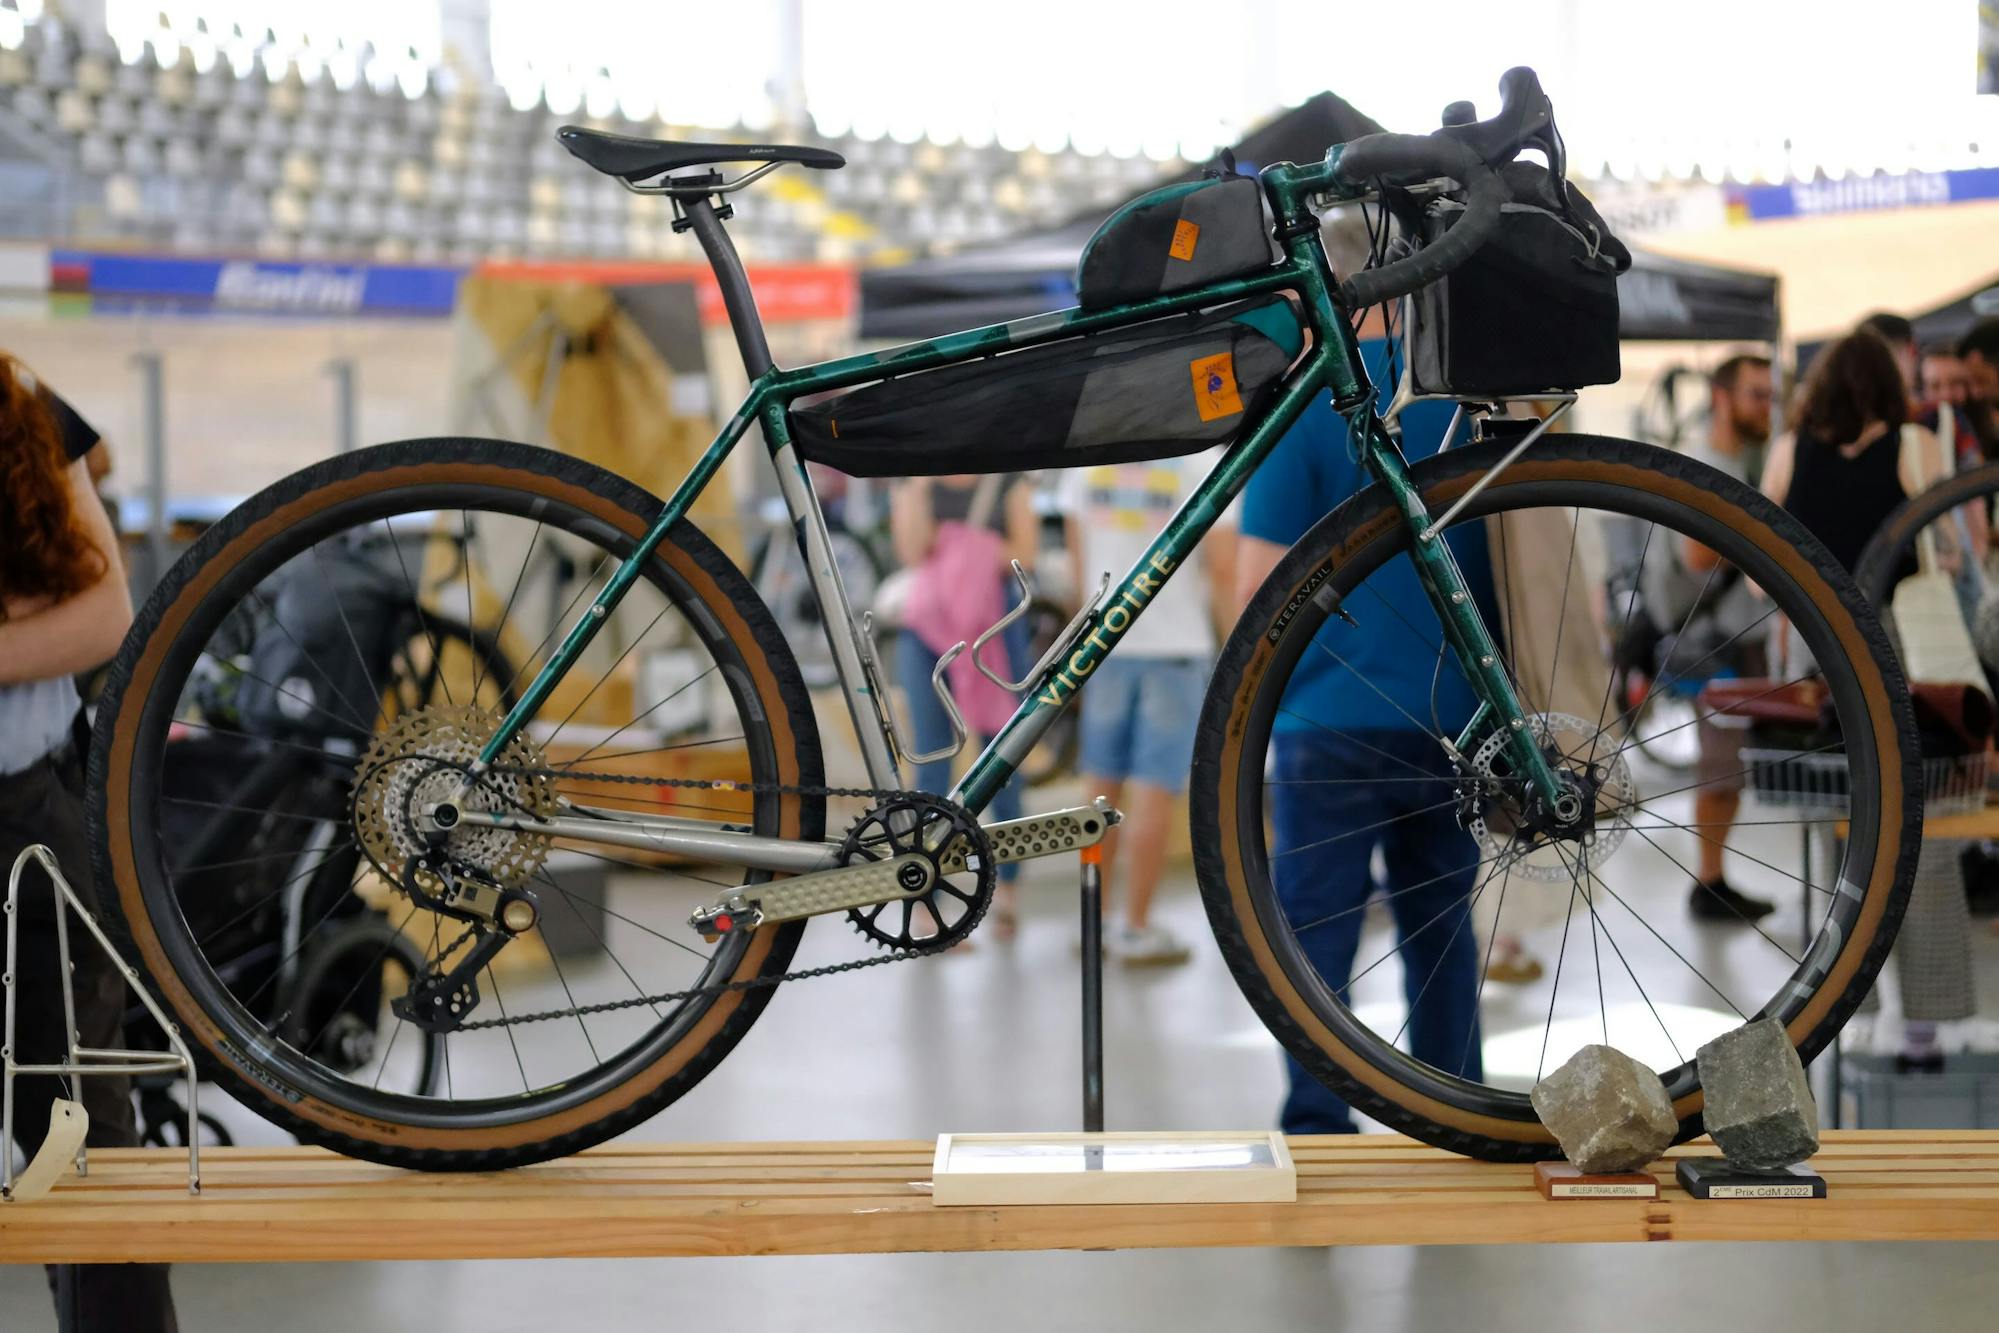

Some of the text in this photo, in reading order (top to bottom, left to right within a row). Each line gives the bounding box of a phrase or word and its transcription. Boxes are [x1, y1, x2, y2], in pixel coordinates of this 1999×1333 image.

[1277, 566, 1331, 627] TERAVAIL
[1038, 550, 1175, 706] VICTOIRE
[1569, 1186, 1638, 1195] MEILLEUR TRAVAIL ARTISANAL
[1735, 1187, 1754, 1197] Prix
[1757, 1187, 1781, 1197] CdM
[1784, 1187, 1809, 1196] 2022
